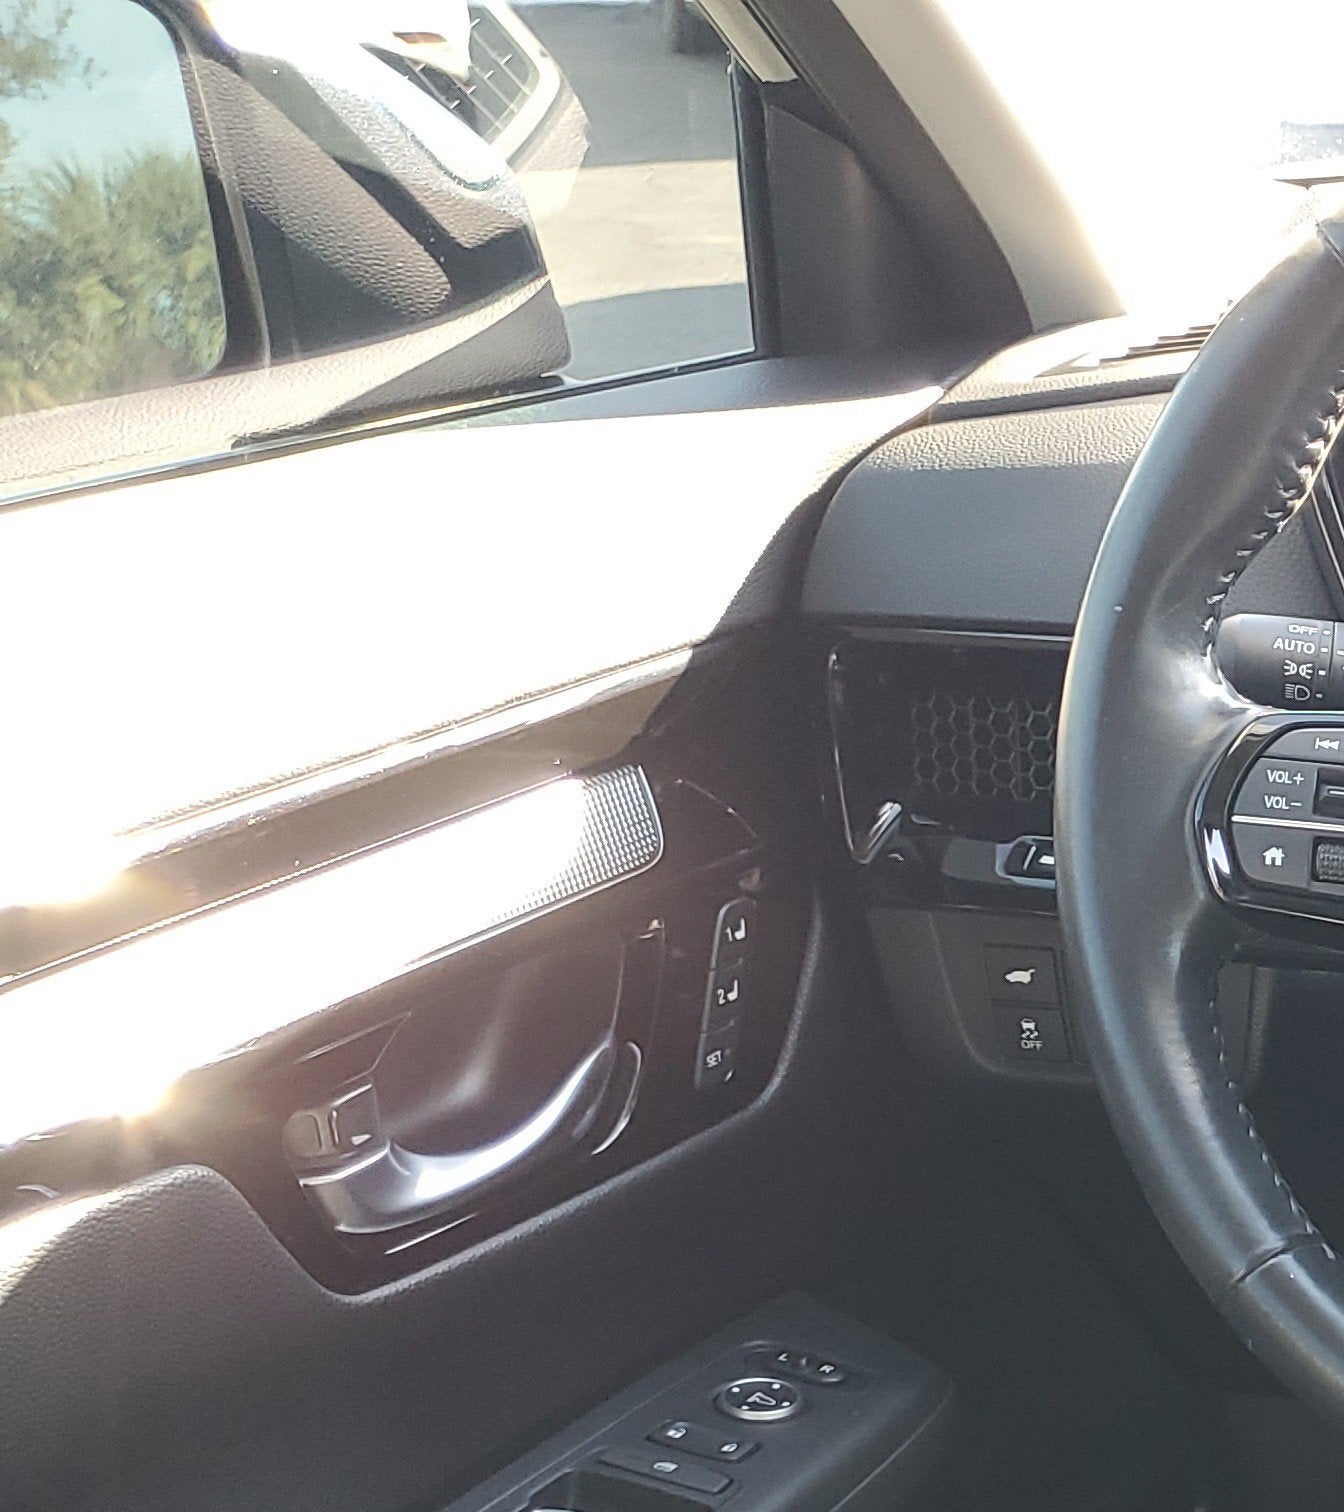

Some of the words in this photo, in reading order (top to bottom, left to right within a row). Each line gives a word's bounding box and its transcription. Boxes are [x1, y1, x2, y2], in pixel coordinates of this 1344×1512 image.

[1288, 624, 1319, 635] OFF
[1272, 638, 1316, 654] AUTO
[1021, 1039, 1042, 1050] OFF
[706, 1049, 722, 1068] SET
[778, 1353, 790, 1361] L
[819, 1365, 835, 1374] R
